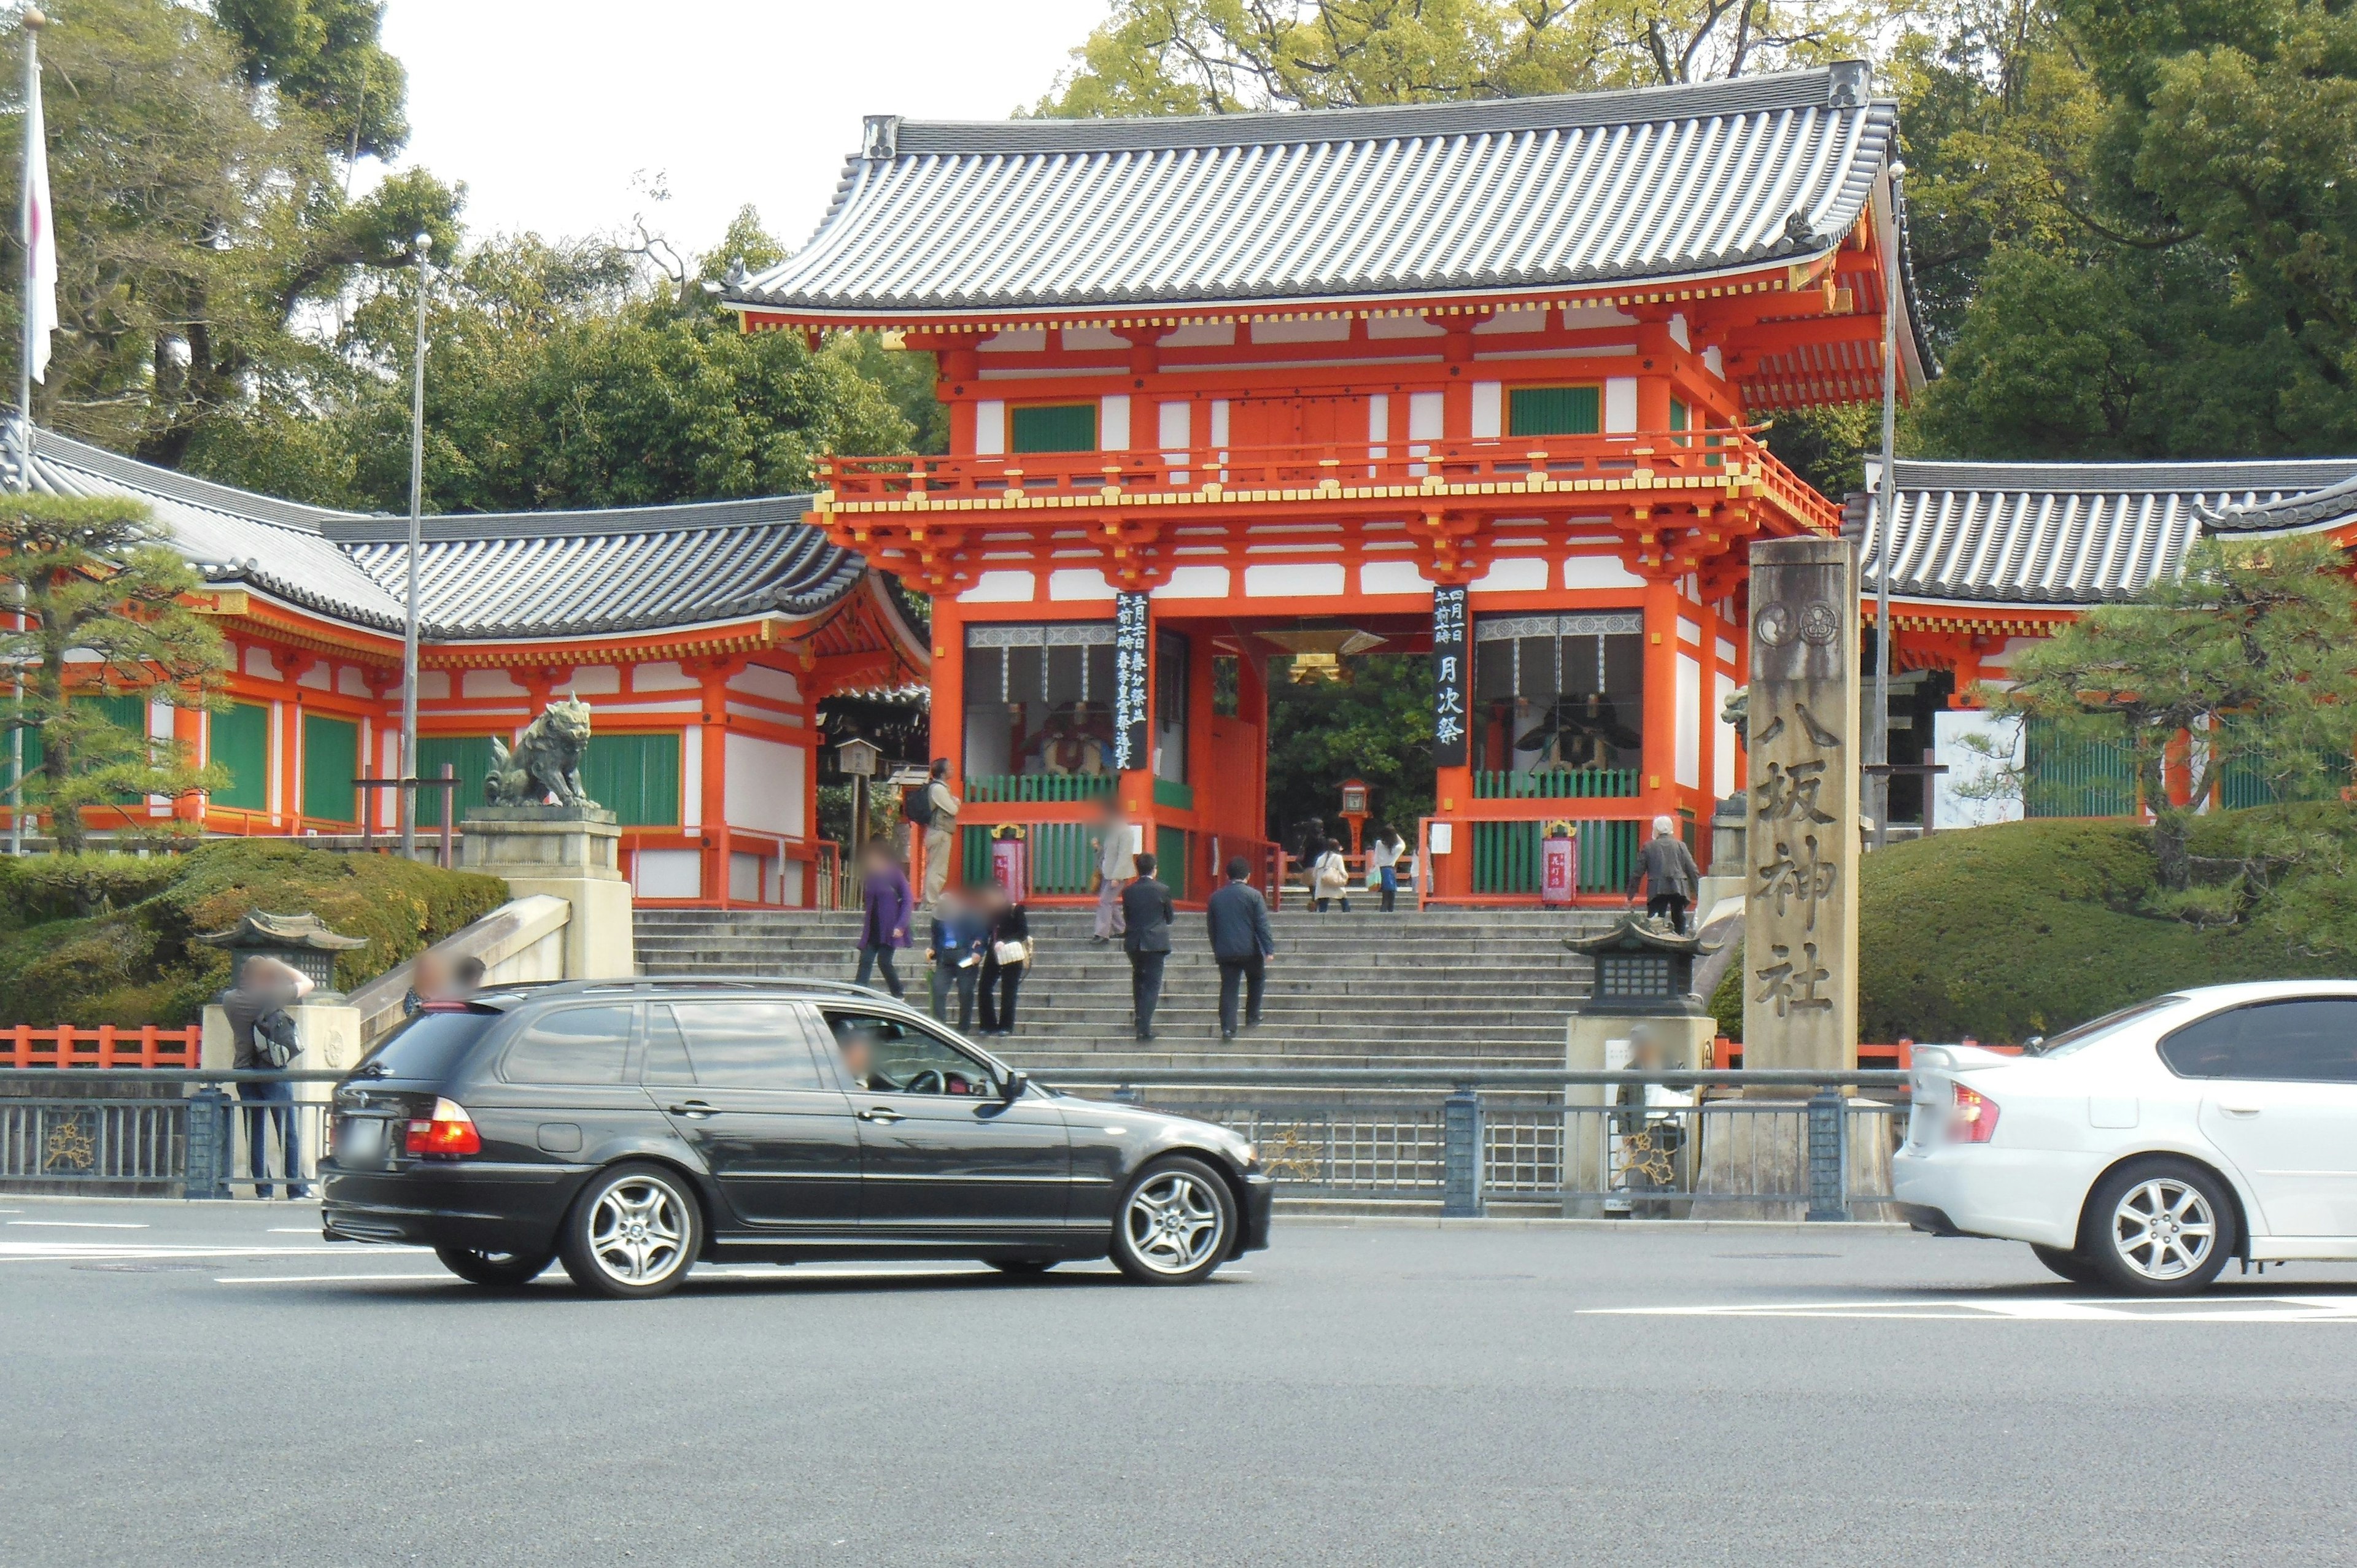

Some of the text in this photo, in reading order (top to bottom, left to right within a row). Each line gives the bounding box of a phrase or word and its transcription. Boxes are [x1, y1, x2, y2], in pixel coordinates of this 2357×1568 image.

[1434, 590, 1451, 644] 午前十時
[1449, 590, 1465, 642] 四月一日
[1436, 656, 1465, 746] 月次祭
[1753, 703, 1841, 1018] 八坂神社
